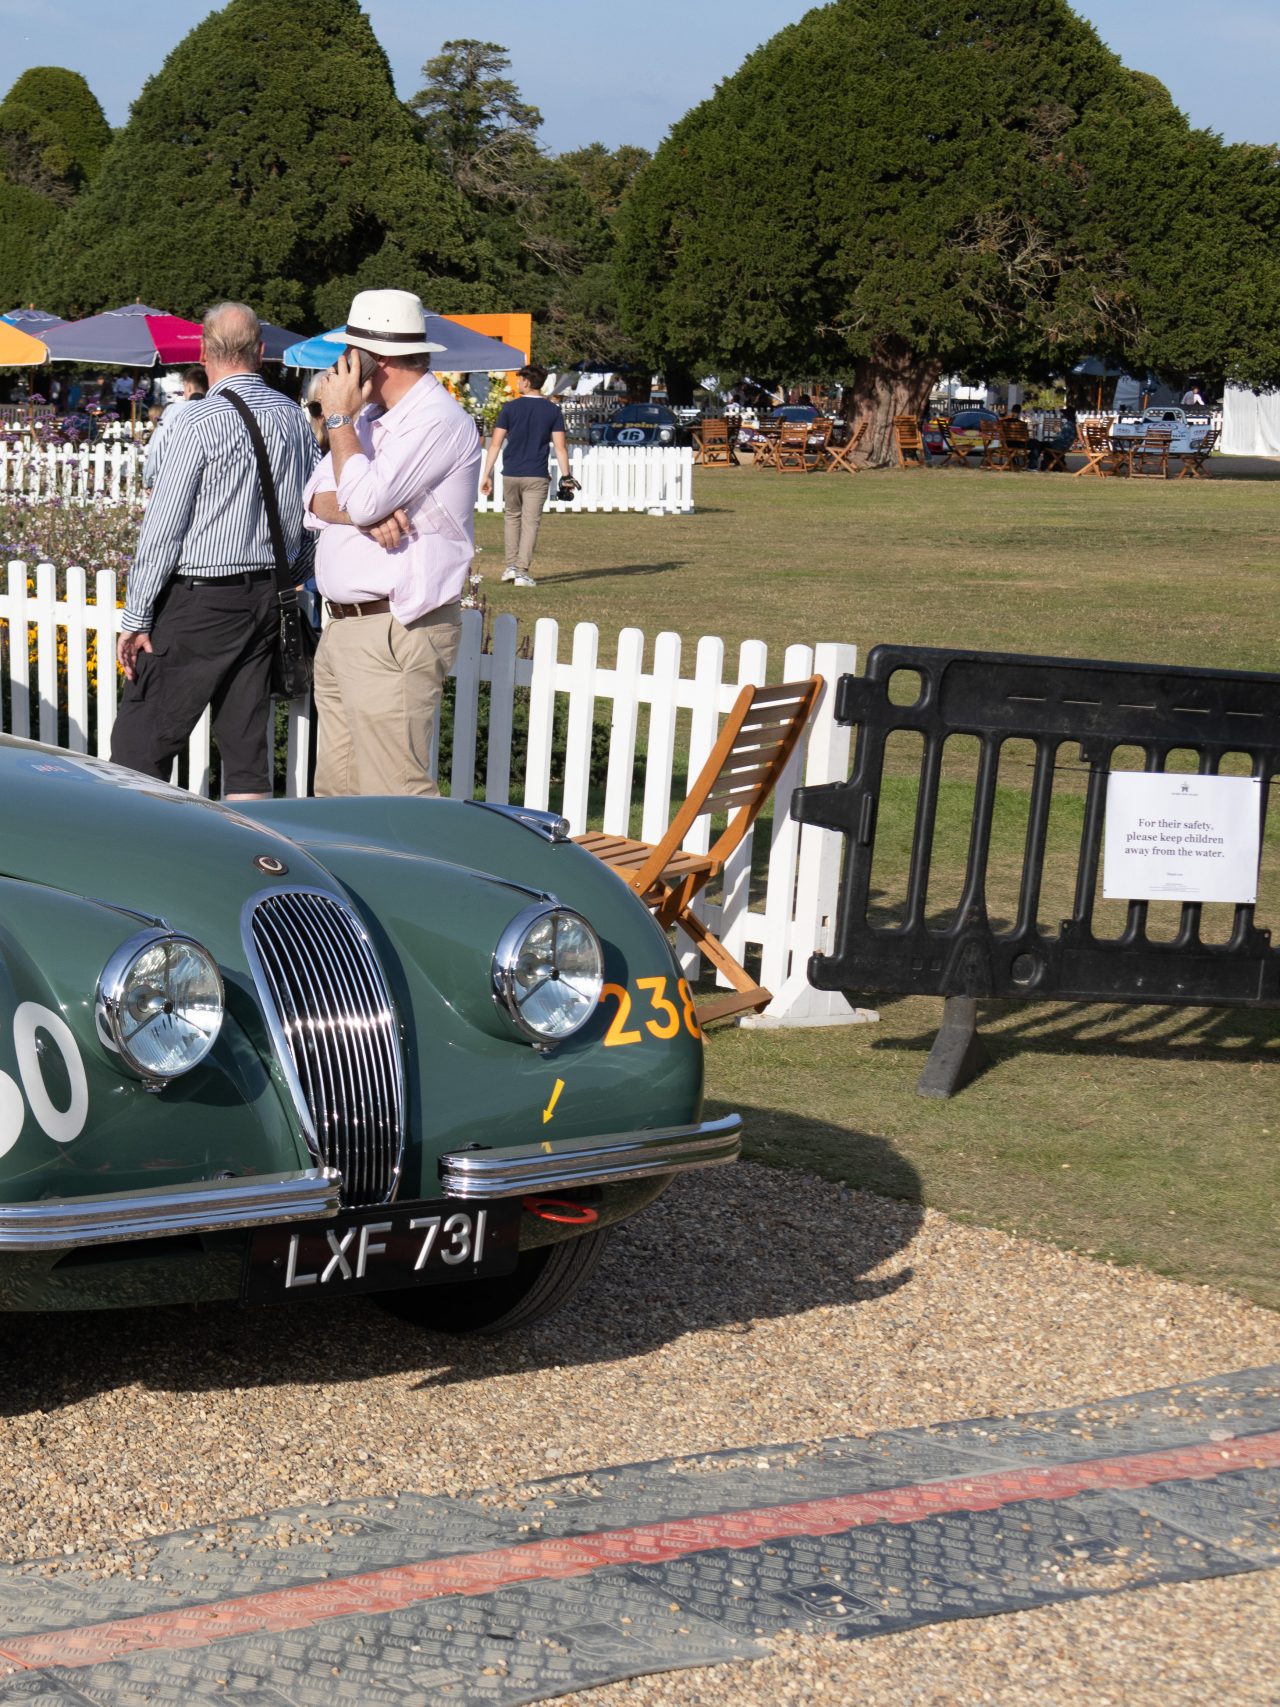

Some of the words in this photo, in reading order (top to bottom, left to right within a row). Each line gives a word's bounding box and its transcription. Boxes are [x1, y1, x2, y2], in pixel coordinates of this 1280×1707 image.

[621, 431, 640, 439] 16
[1138, 818, 1156, 828] For
[1158, 819, 1182, 829] their
[1126, 832, 1158, 843] please
[1160, 833, 1183, 844] keep
[1184, 834, 1224, 844] children
[1124, 848, 1150, 857] away
[1152, 846, 1176, 856] from
[1178, 847, 1193, 856] the
[1195, 850, 1225, 858] water.
[598, 976, 701, 1047] 238
[284, 1221, 393, 1289] LXF
[409, 1209, 488, 1271] 731
